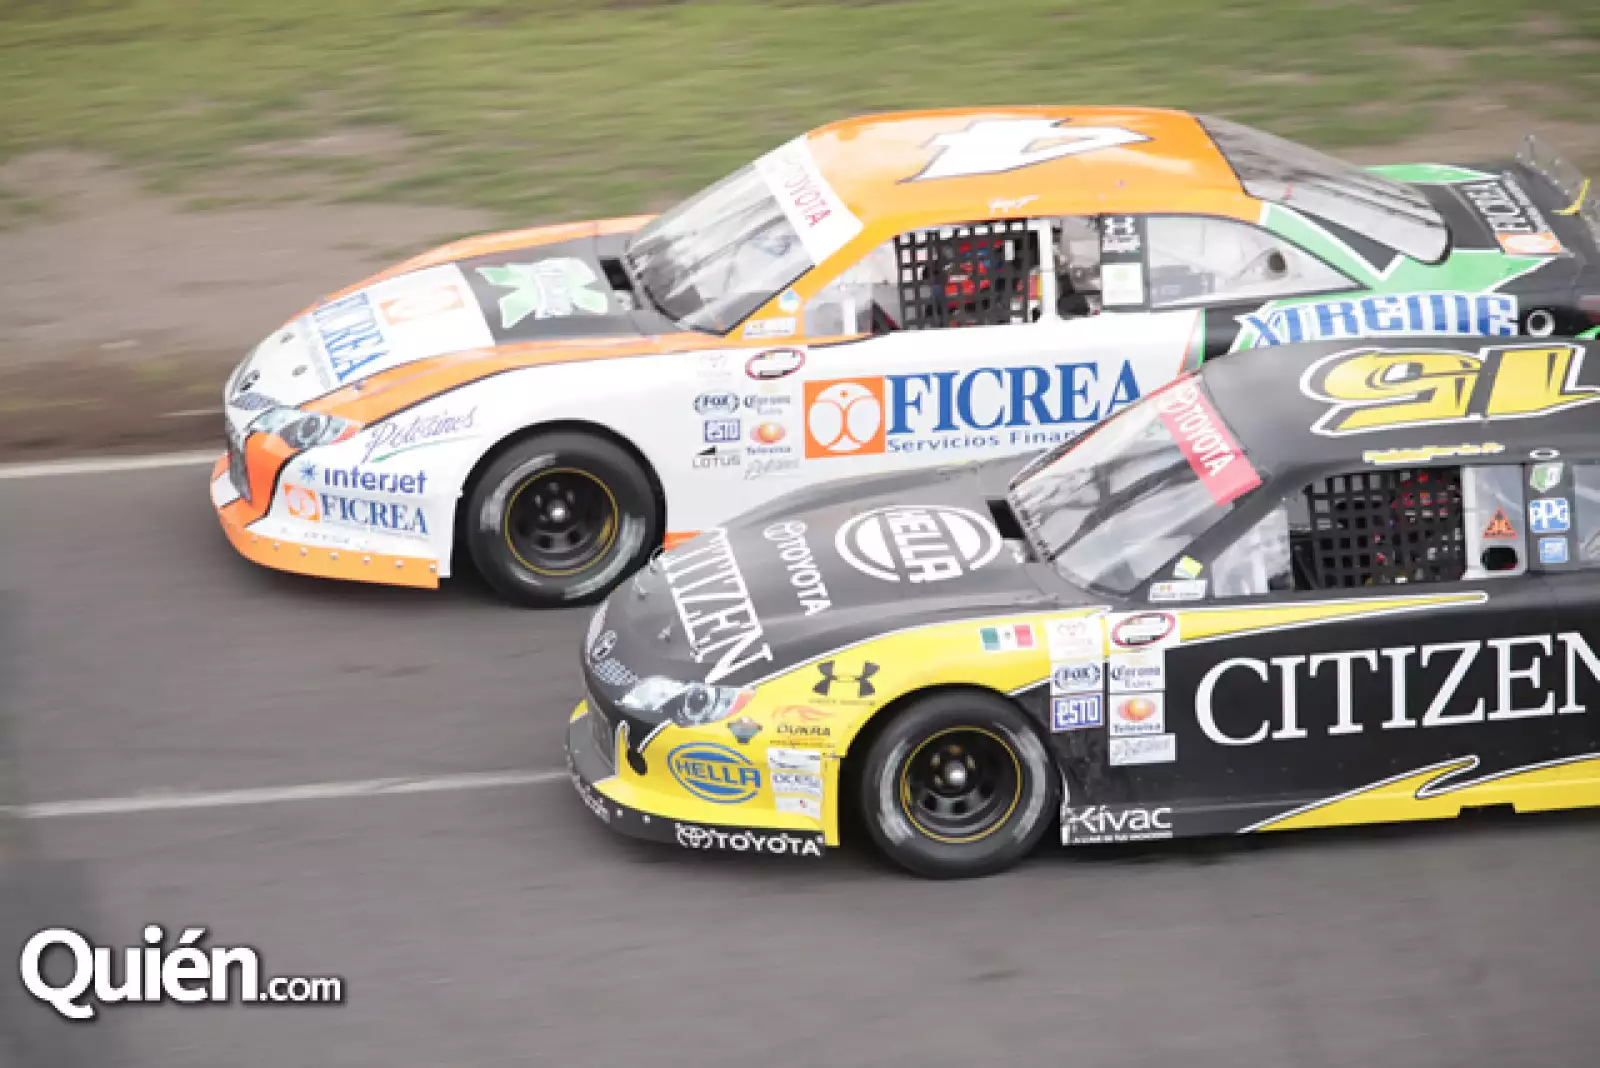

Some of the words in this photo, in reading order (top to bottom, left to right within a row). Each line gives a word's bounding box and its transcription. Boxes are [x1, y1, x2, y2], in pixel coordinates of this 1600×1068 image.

[885, 358, 1141, 435] FICREA
[887, 436, 1000, 453] Servicios
[1173, 403, 1236, 478] TOYOTA
[320, 492, 428, 534] FICREA
[776, 537, 831, 616] TOYOTA
[675, 759, 761, 789] HELLA
[712, 832, 821, 857] TOYOTA
